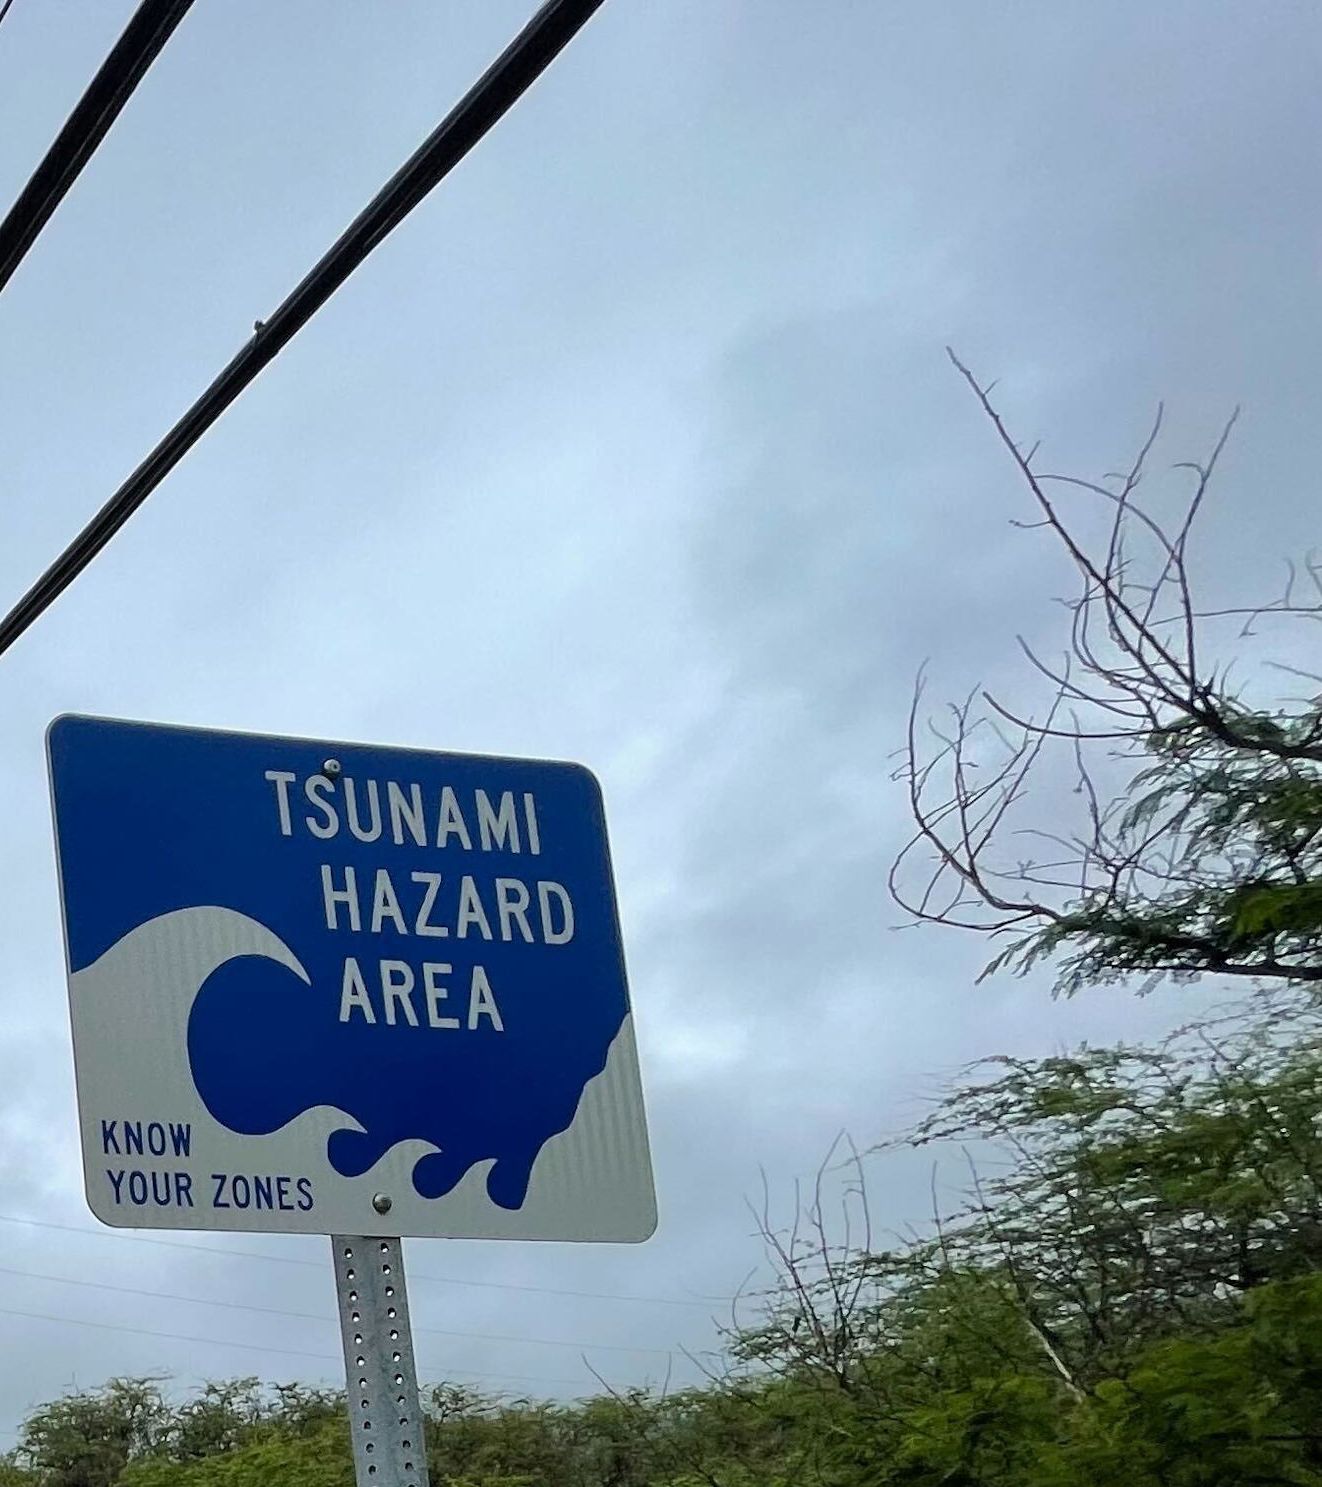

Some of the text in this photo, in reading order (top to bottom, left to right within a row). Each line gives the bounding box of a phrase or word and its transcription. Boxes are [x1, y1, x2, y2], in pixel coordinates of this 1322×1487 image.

[264, 770, 541, 856] TSUNAMI
[320, 864, 575, 946] HAZARD
[338, 957, 505, 1032] AREA
[101, 1119, 192, 1158] KNOW
[106, 1169, 314, 1212] YOUR ZONES
